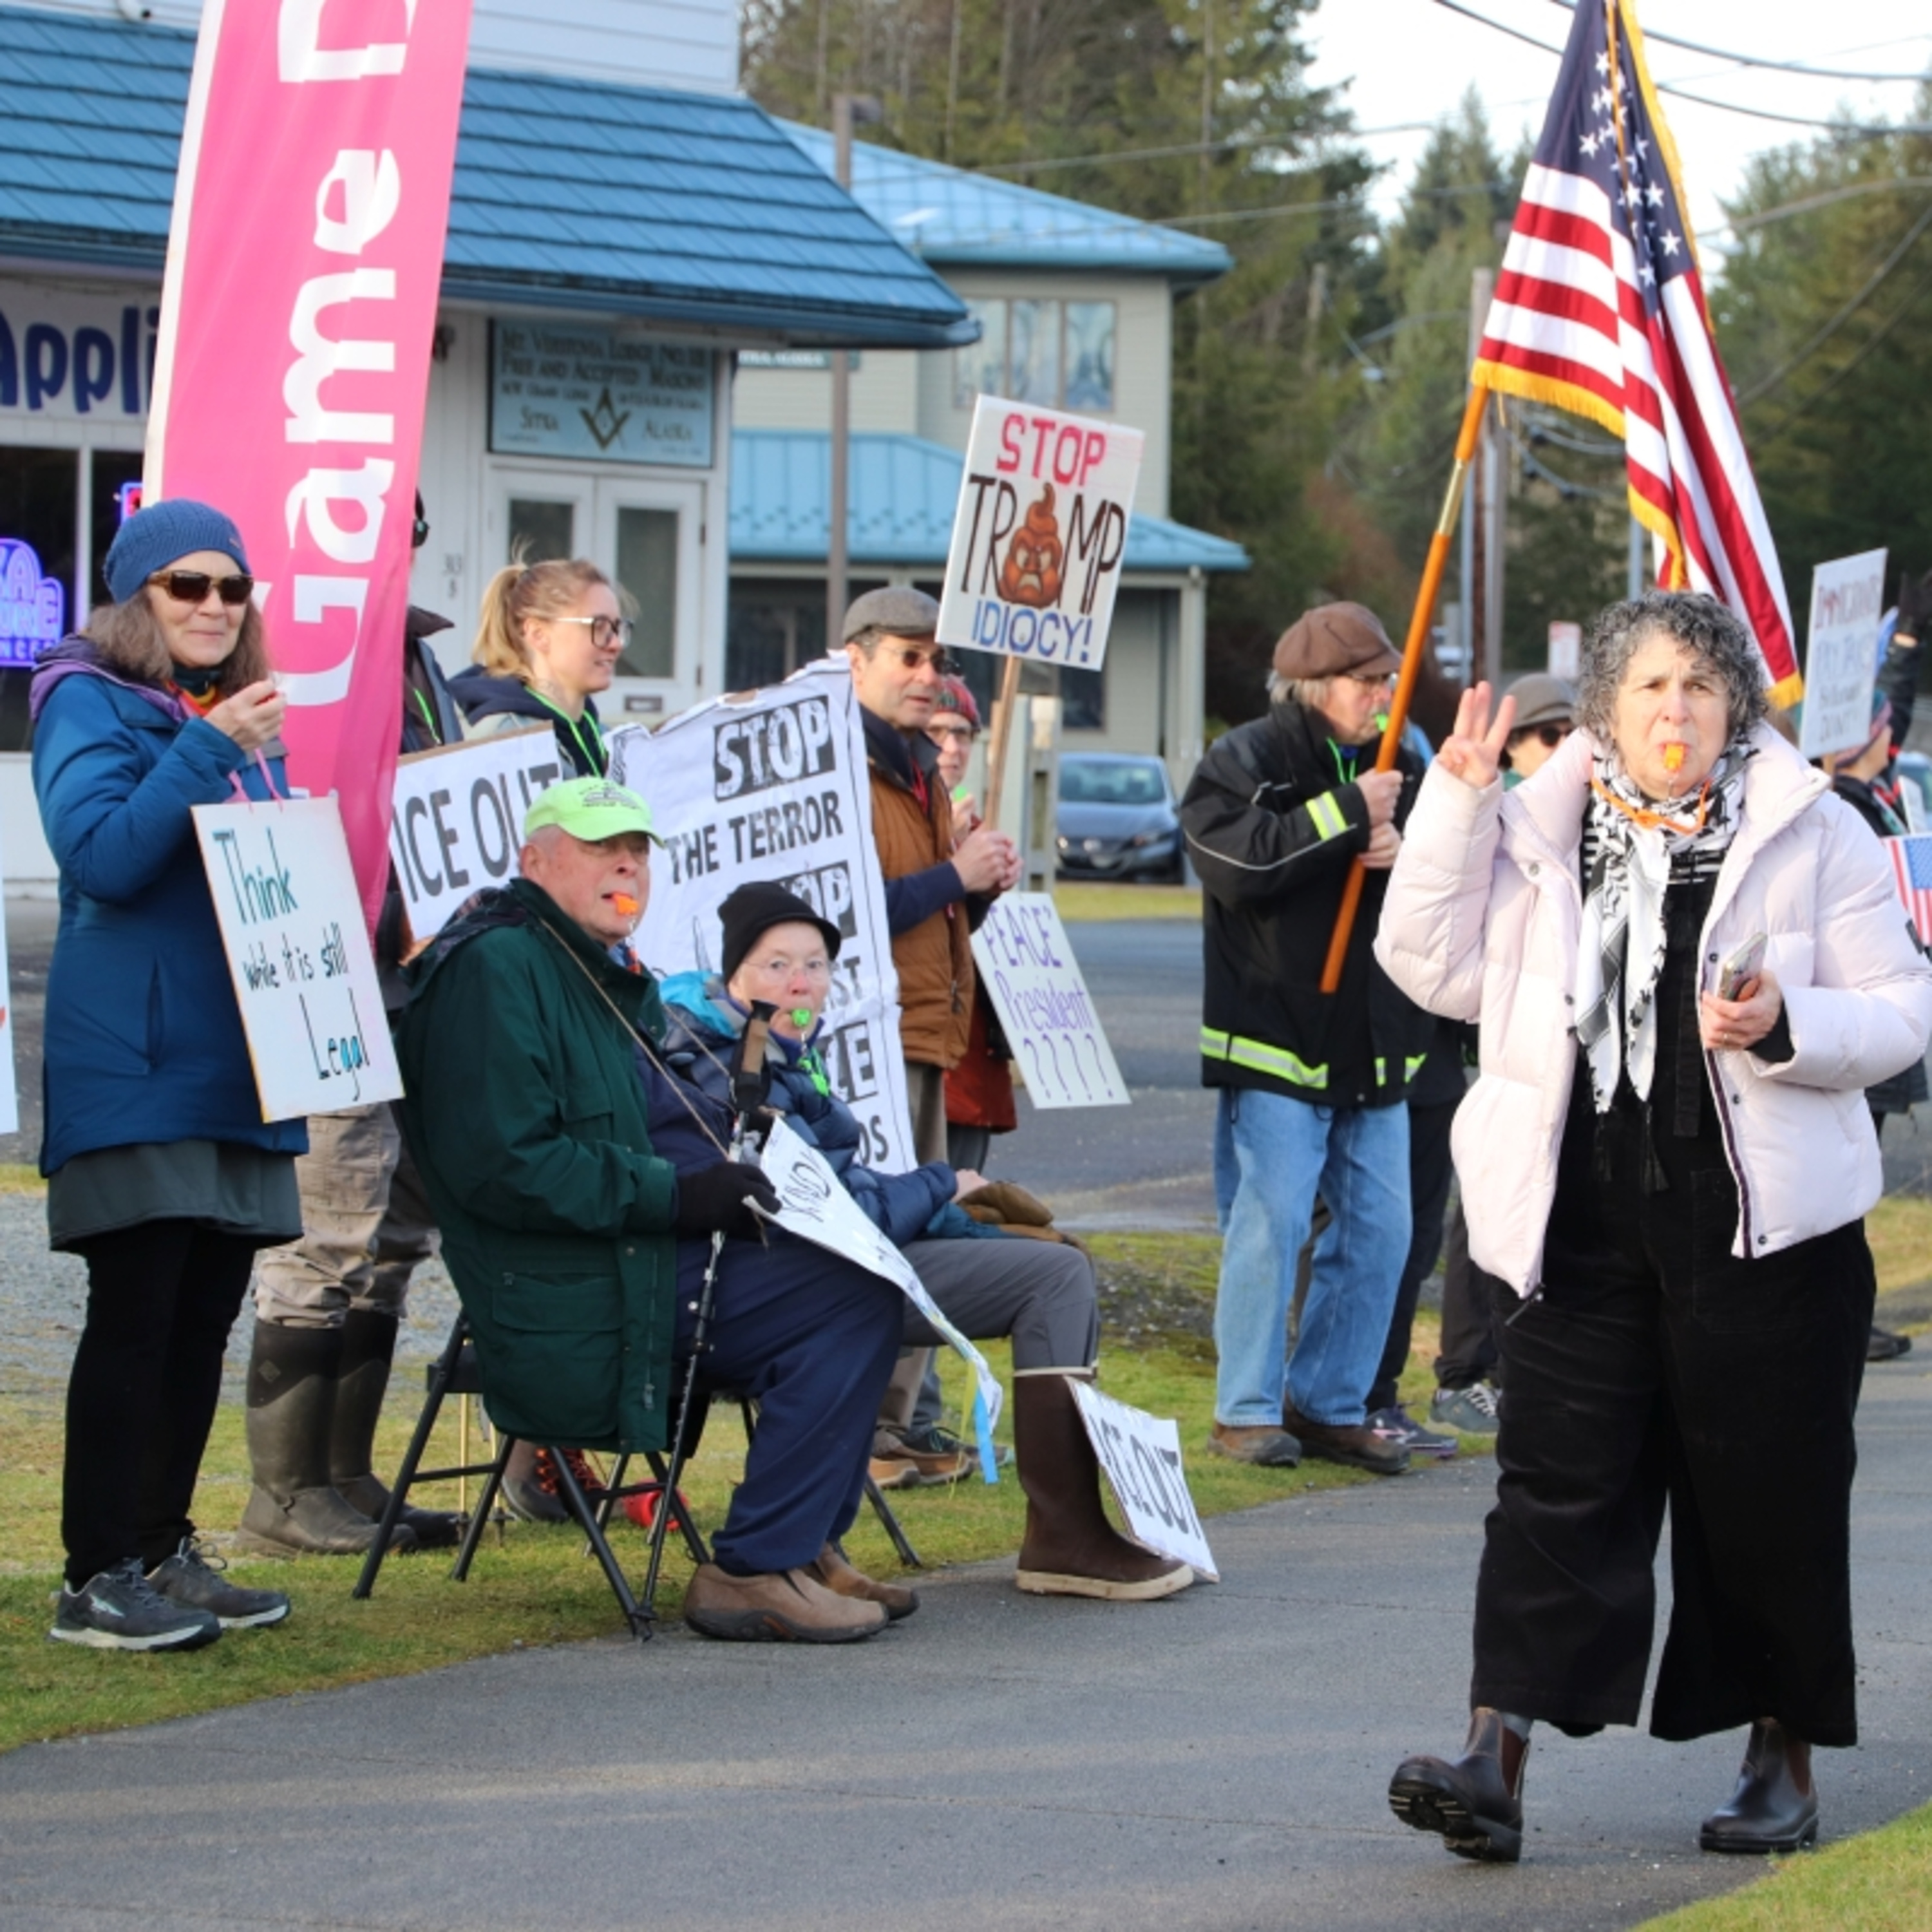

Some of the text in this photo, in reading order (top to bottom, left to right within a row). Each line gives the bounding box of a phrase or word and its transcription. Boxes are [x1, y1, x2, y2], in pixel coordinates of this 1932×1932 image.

[251, 149, 401, 706] Game
[996, 413, 1106, 486] STOP
[971, 600, 1094, 663] IDIOCY!
[716, 699, 829, 799] STOP
[213, 827, 298, 925] Think
[392, 762, 560, 903] ICE OUT
[664, 790, 844, 885] THE TERROR
[243, 941, 279, 991] while
[321, 922, 350, 978] still
[299, 987, 370, 1101] Legal
